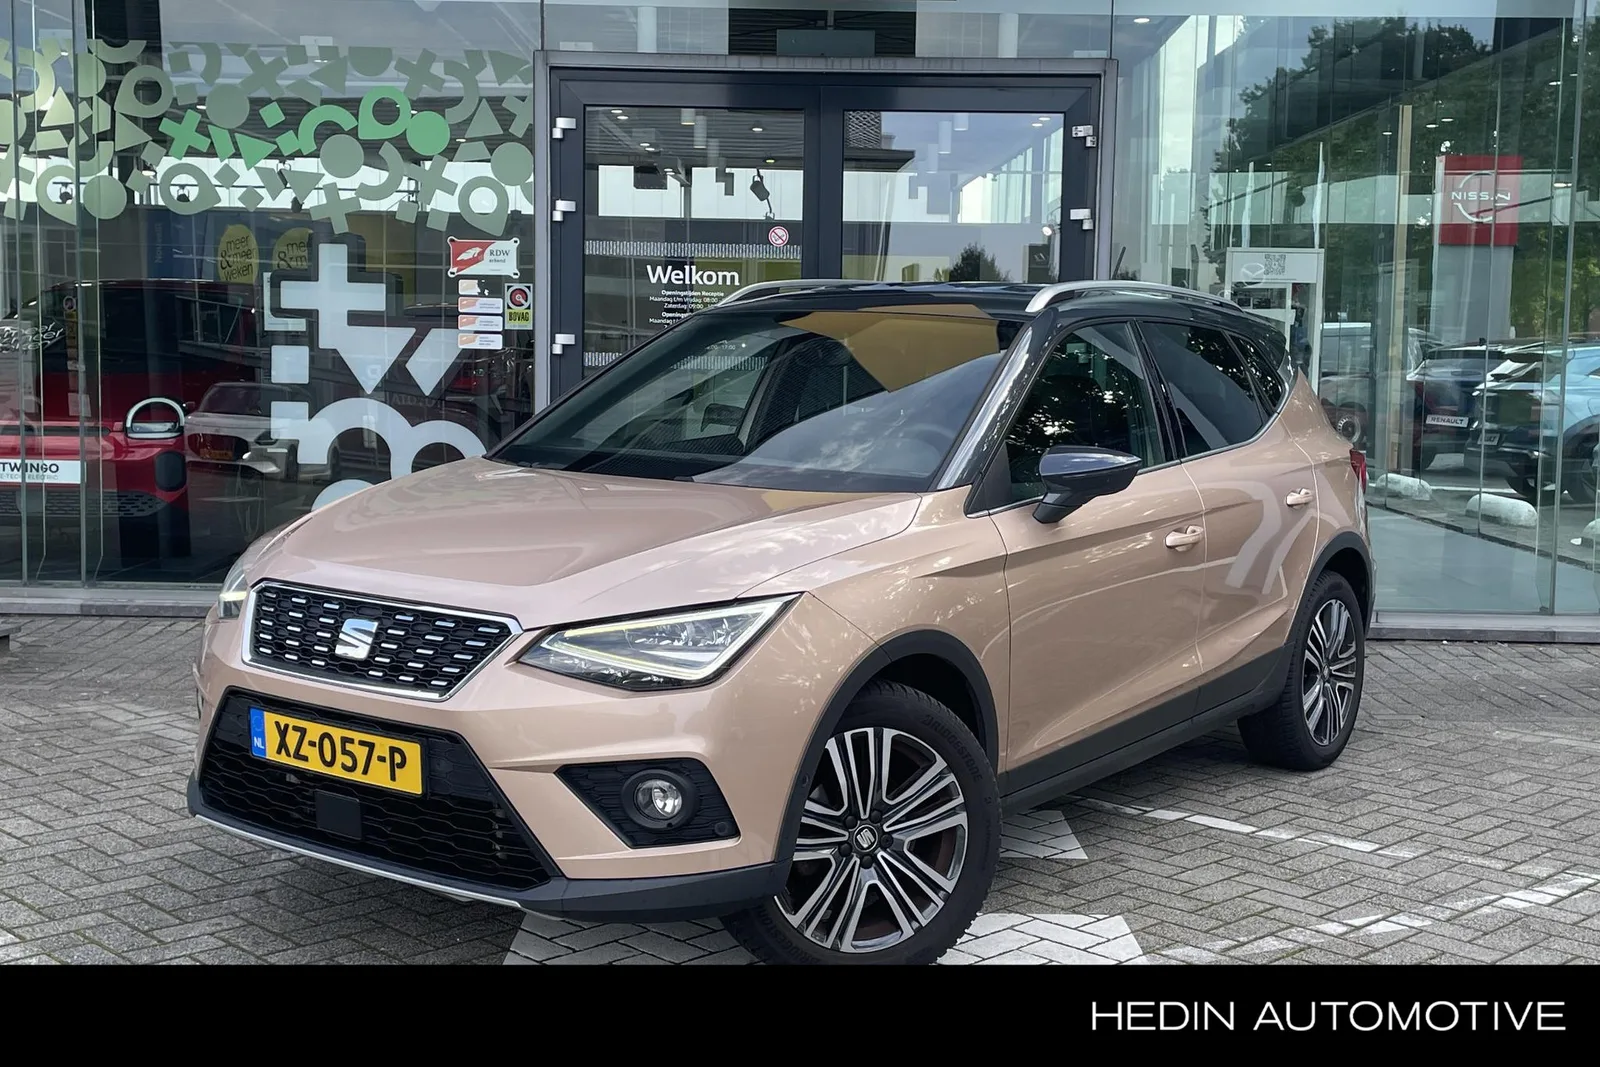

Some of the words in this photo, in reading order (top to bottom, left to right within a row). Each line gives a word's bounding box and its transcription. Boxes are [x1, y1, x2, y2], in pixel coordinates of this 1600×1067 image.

[1451, 191, 1511, 201] NISSN
[226, 234, 250, 252] meer
[489, 249, 511, 257] RDW
[223, 263, 254, 281] weken
[646, 264, 740, 286] Welkom
[508, 311, 530, 322] BOVAG
[1431, 416, 1465, 425] RENAULT
[0, 461, 60, 474] TWINGO
[253, 736, 265, 750] NL
[274, 720, 408, 783] XZ-057-P
